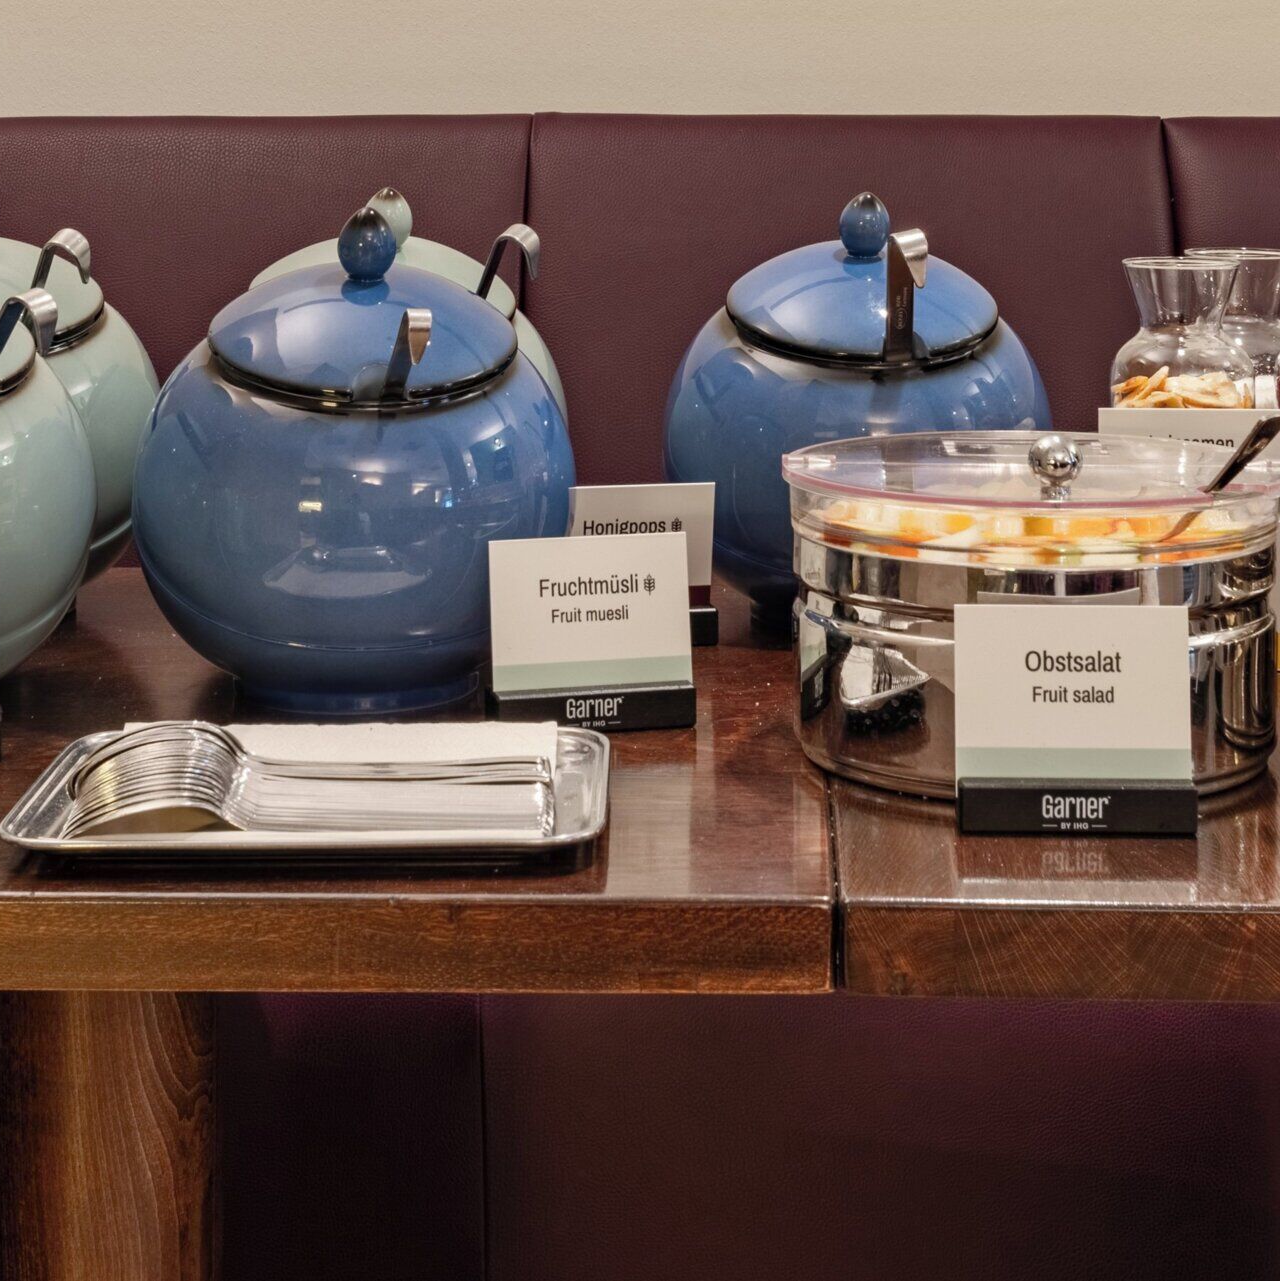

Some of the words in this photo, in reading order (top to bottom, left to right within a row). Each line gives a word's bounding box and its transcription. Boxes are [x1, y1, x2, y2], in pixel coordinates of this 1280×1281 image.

[539, 573, 639, 598] Fruchtmüsli
[551, 606, 582, 624] Fruit
[586, 605, 629, 622] muesli
[1025, 650, 1122, 673] Obstsalat
[1032, 686, 1068, 703] Fruit
[1072, 685, 1115, 704] salad
[566, 697, 623, 719] Garner
[1042, 794, 1110, 819] Garner
[1074, 822, 1089, 830] IHG
